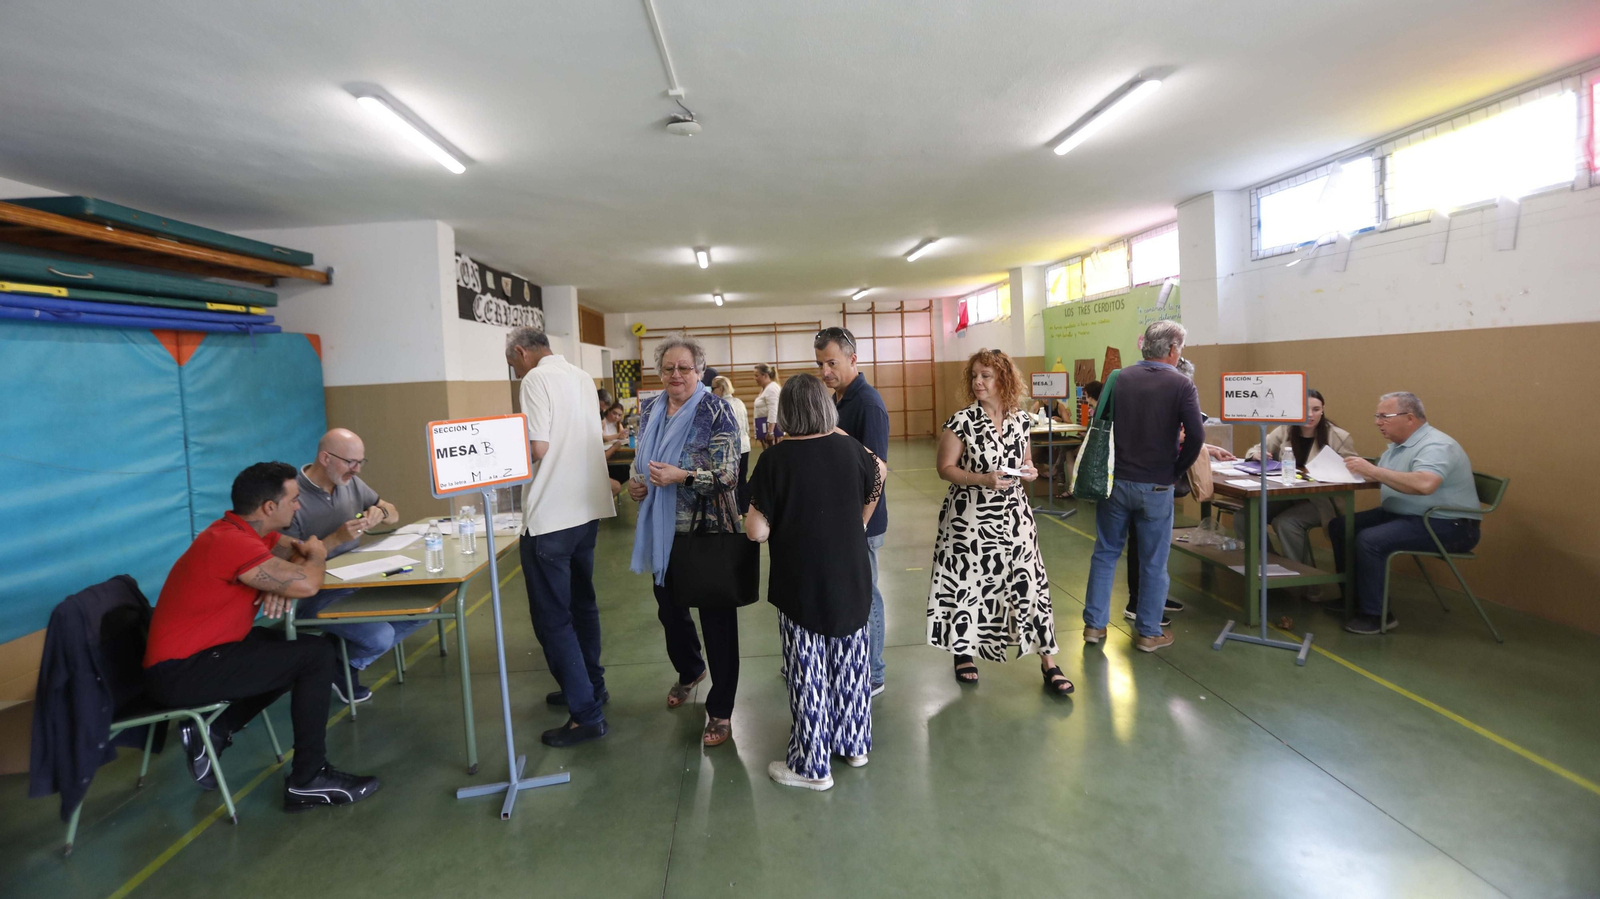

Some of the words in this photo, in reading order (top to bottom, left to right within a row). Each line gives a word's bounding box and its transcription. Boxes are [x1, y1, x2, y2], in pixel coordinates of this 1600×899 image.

[473, 294, 544, 330] CERVANTES
[1064, 308, 1074, 317] LOS
[1078, 304, 1090, 315] TRES
[1094, 299, 1125, 313] CERDITOS
[1253, 376, 1264, 385] 5
[1225, 390, 1258, 398] MESA
[1265, 388, 1274, 398] A
[1252, 409, 1260, 417] A
[433, 425, 467, 434] SECCIÓN
[471, 423, 480, 435] 5
[436, 444, 477, 459] MESA
[481, 441, 494, 455] B
[471, 471, 481, 482] M
[503, 468, 512, 477] Z
